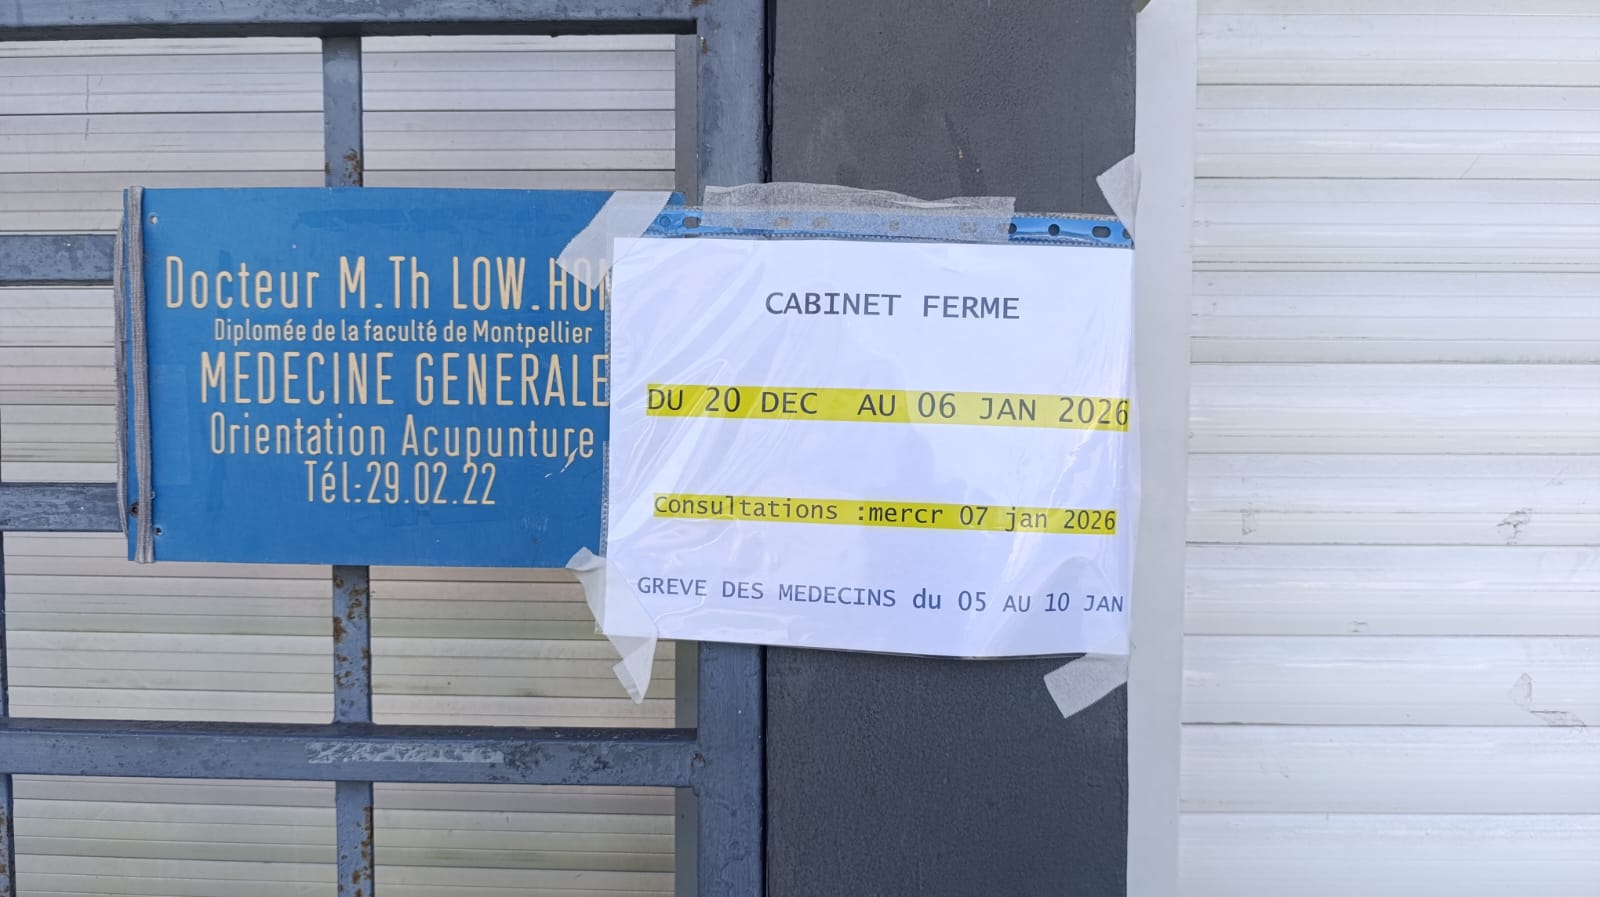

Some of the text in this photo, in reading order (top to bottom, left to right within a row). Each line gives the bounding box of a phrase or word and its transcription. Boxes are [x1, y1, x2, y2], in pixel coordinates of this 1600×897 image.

[165, 255, 320, 311] Docteur
[339, 255, 430, 311] M.Th
[765, 292, 1021, 320] CABINET FERME
[214, 318, 593, 349] Diplomée de la faculté de Montpellier
[200, 351, 611, 407] MEDECINE GENERALE
[647, 387, 1129, 426] DU 20 DEC AU 06 JAN 2026
[210, 411, 595, 467] Orientation Acupunture
[654, 495, 839, 520] Consultations
[959, 505, 988, 527] 07
[1004, 509, 1048, 532] jan
[1063, 509, 1116, 531] 2026
[637, 576, 1124, 614] GREVE DES MEDECINS du 05 AU 10 JAN
